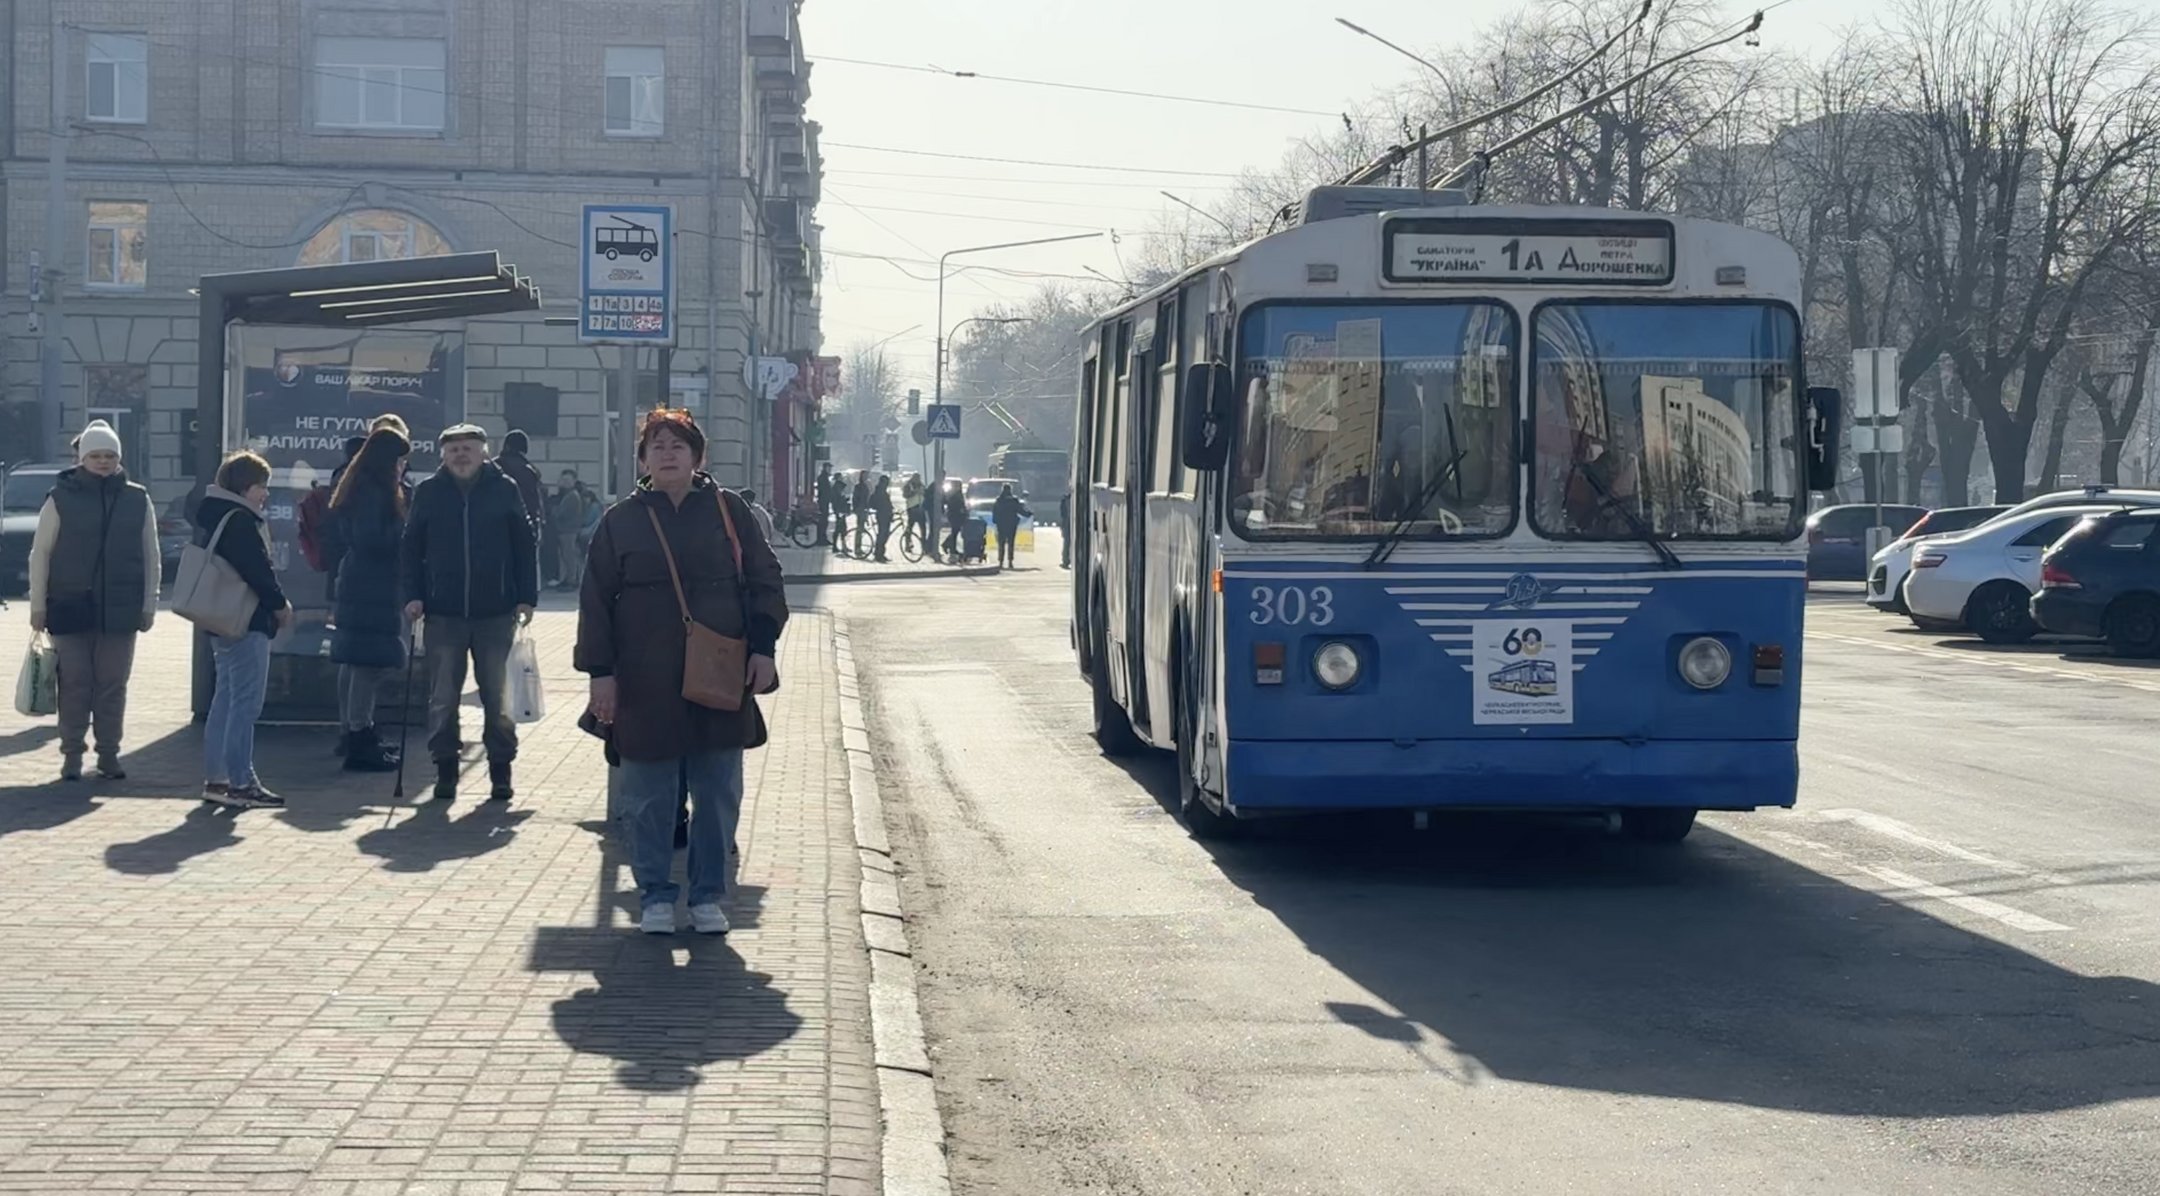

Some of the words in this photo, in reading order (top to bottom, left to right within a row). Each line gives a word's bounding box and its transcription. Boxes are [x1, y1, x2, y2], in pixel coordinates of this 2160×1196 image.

[622, 299, 630, 309] 3
[592, 317, 599, 327] 7
[315, 374, 343, 385] ВАШ
[382, 376, 422, 388] ПОРУЧ
[296, 416, 319, 429] НЕ
[1250, 586, 1334, 626] 303
